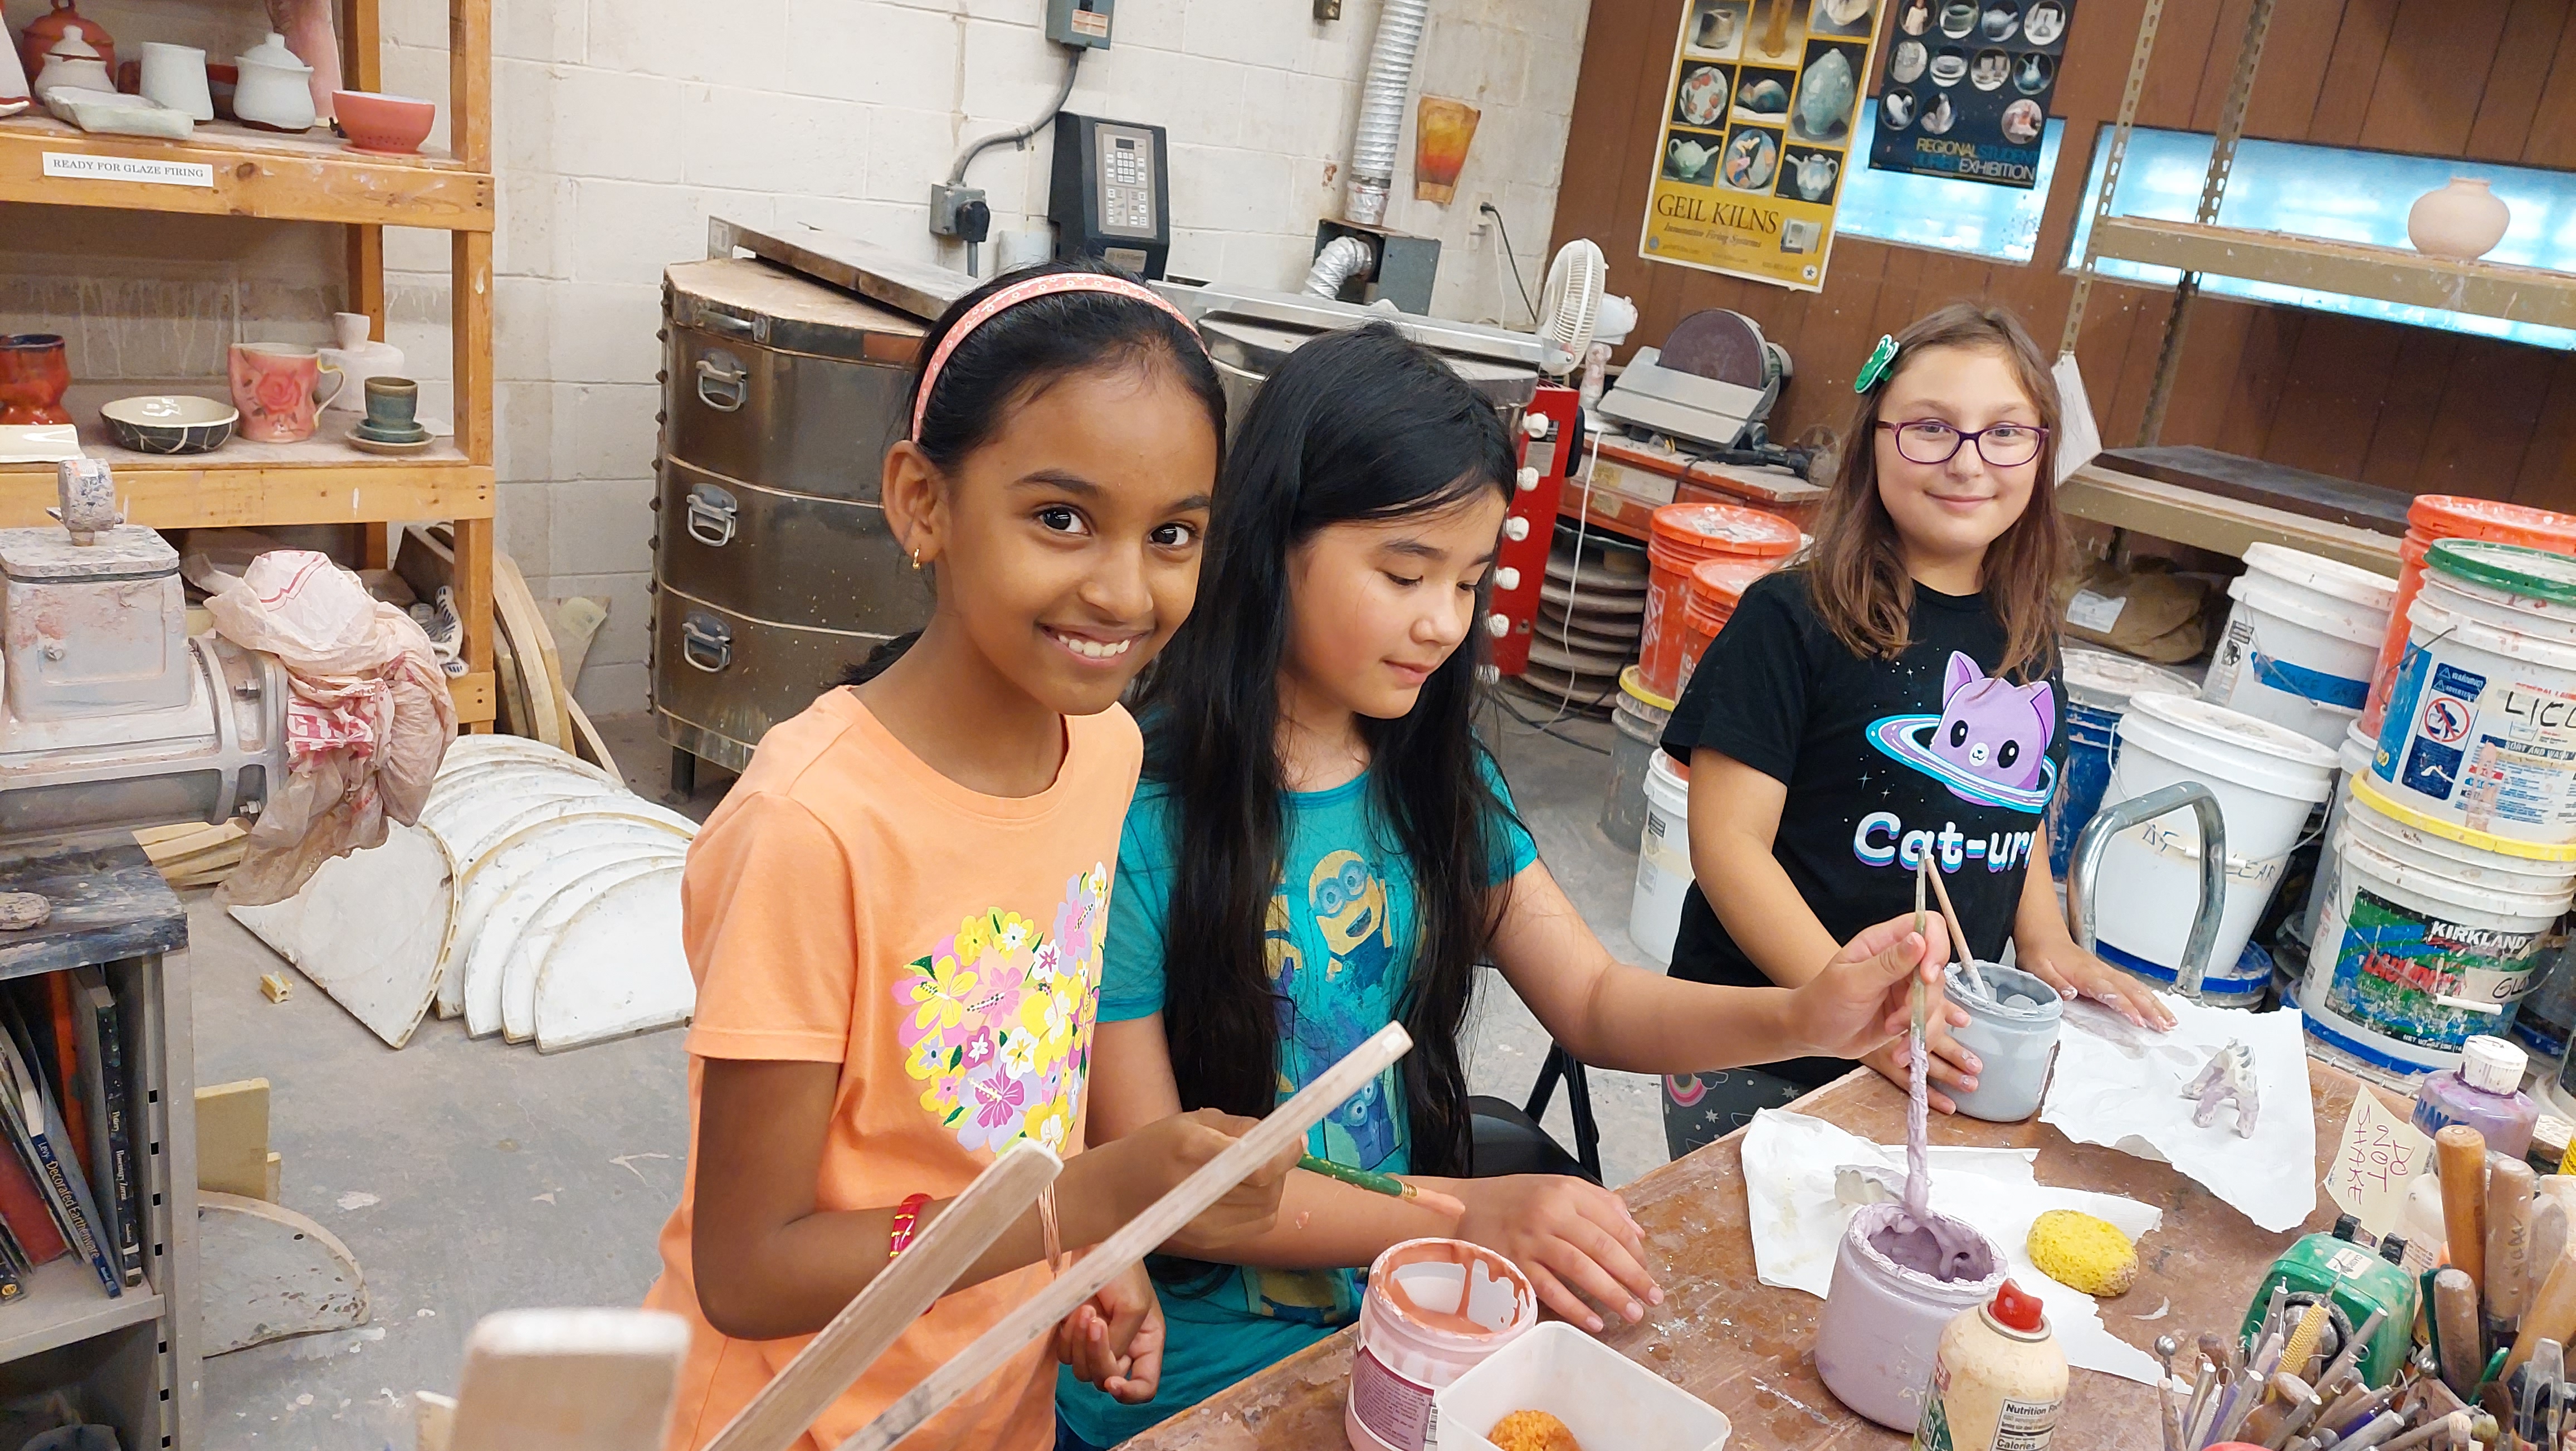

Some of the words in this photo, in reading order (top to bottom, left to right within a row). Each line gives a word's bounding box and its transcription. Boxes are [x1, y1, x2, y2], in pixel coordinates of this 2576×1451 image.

[1916, 137, 1977, 157] REGIONAL
[53, 159, 94, 170] READY
[97, 162, 121, 172] FOR
[123, 164, 162, 175] GLAZE
[164, 167, 204, 178] FIRING
[1959, 157, 2035, 180] EXHIBITION
[1657, 193, 1706, 222] GEIL
[1711, 201, 1779, 234] KILNS
[2431, 921, 2528, 952] KIRKLAND
[37, 1141, 51, 1159] Levy
[2347, 1104, 2370, 1205] SHAKE
[2368, 1124, 2391, 1192] NOT
[2390, 1140, 2416, 1176] DO
[46, 1160, 75, 1207] Decorated
[68, 1204, 100, 1258] Earthenware
[2006, 1403, 2046, 1416] Nutrition
[1997, 1438, 2036, 1450] Calories
